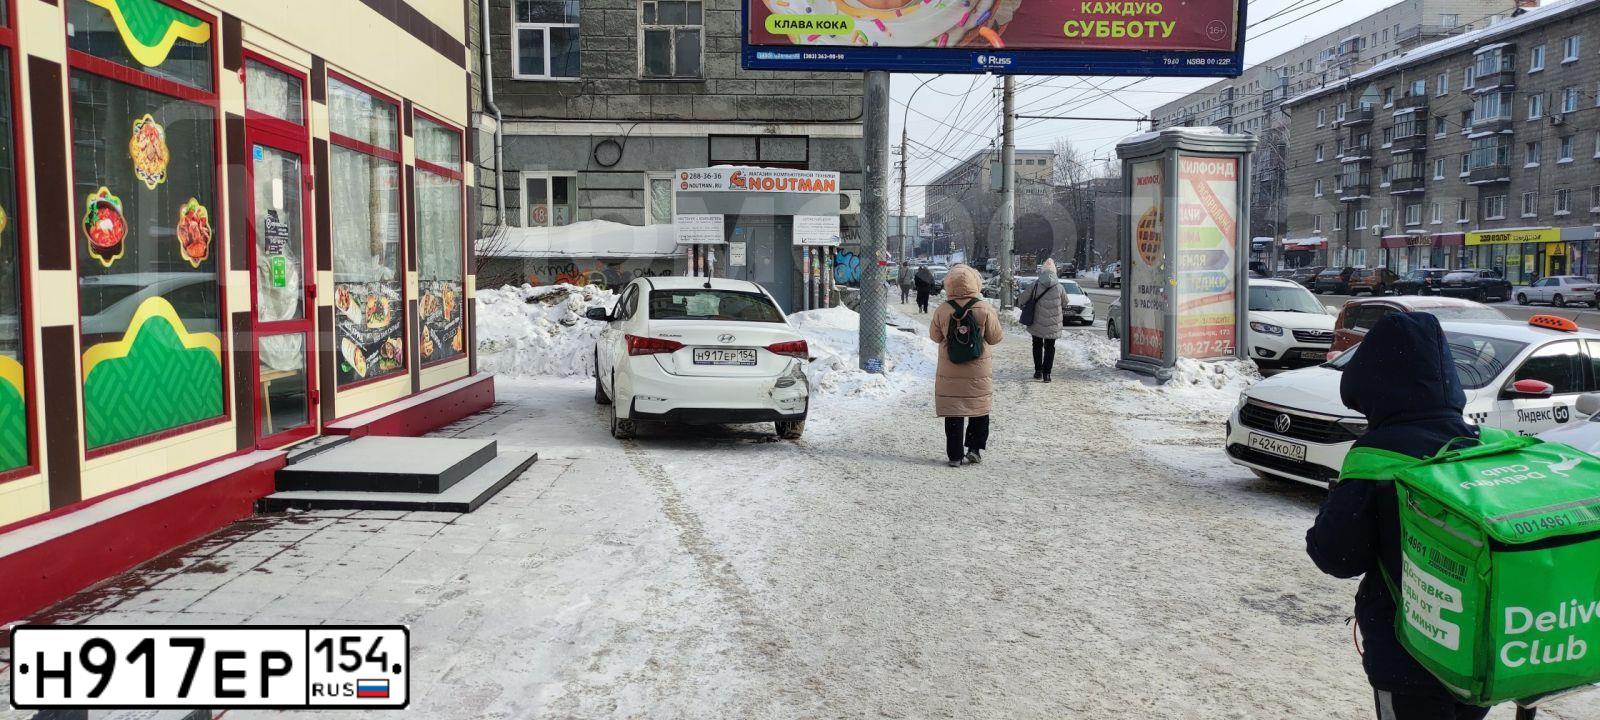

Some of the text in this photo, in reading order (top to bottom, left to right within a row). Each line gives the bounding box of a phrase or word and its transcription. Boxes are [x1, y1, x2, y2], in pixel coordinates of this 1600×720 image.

[1081, 2, 1163, 16] КАЖДУЮ
[774, 19, 848, 31] КЛАВА КОКА
[1063, 20, 1177, 39] СУББОТУ
[1208, 26, 1224, 35] 16+
[988, 55, 1012, 65] Russ
[689, 172, 722, 180] 288-36-36
[748, 177, 836, 193] NOUTMAN
[697, 348, 753, 361] Н917ЕР 154
[1517, 406, 1568, 423] Яндекс Go
[1252, 437, 1289, 455] Р424КО
[1481, 464, 1530, 477] Club
[1460, 471, 1547, 489] Delivery
[1516, 513, 1572, 536] 0014961
[1403, 560, 1453, 603] Доставка
[1420, 600, 1433, 614] от
[1412, 610, 1449, 640] минут
[1500, 634, 1588, 668] Club
